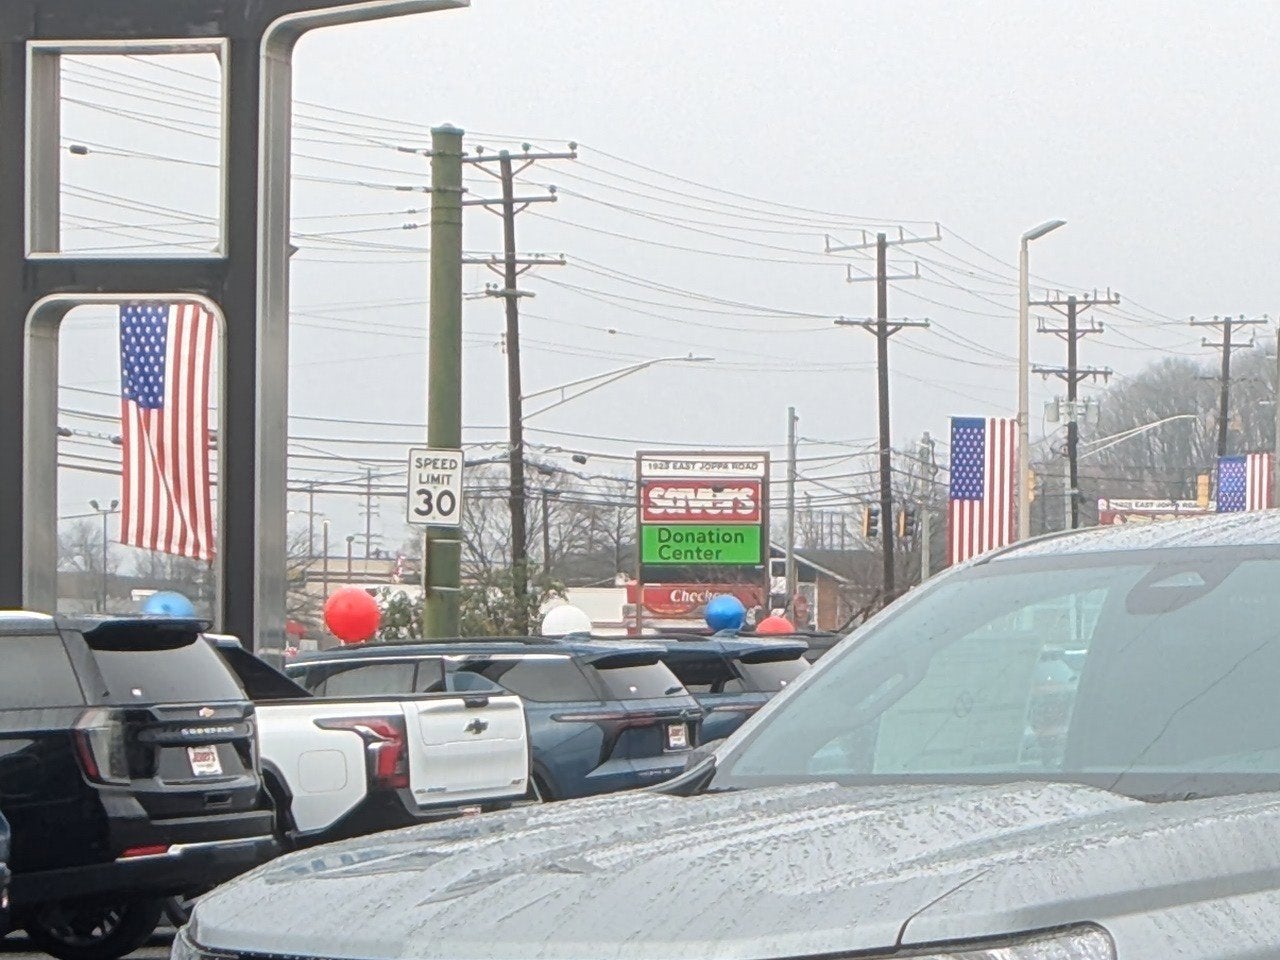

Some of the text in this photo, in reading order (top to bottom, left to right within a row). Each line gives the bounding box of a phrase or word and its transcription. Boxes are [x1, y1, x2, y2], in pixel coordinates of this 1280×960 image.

[415, 457, 458, 470] SPEED
[672, 462, 696, 471] EAST
[731, 462, 759, 471] ROAD
[418, 473, 453, 486] LIMIT
[414, 488, 456, 517] 30
[658, 527, 745, 544] Donation
[658, 544, 722, 560] Center
